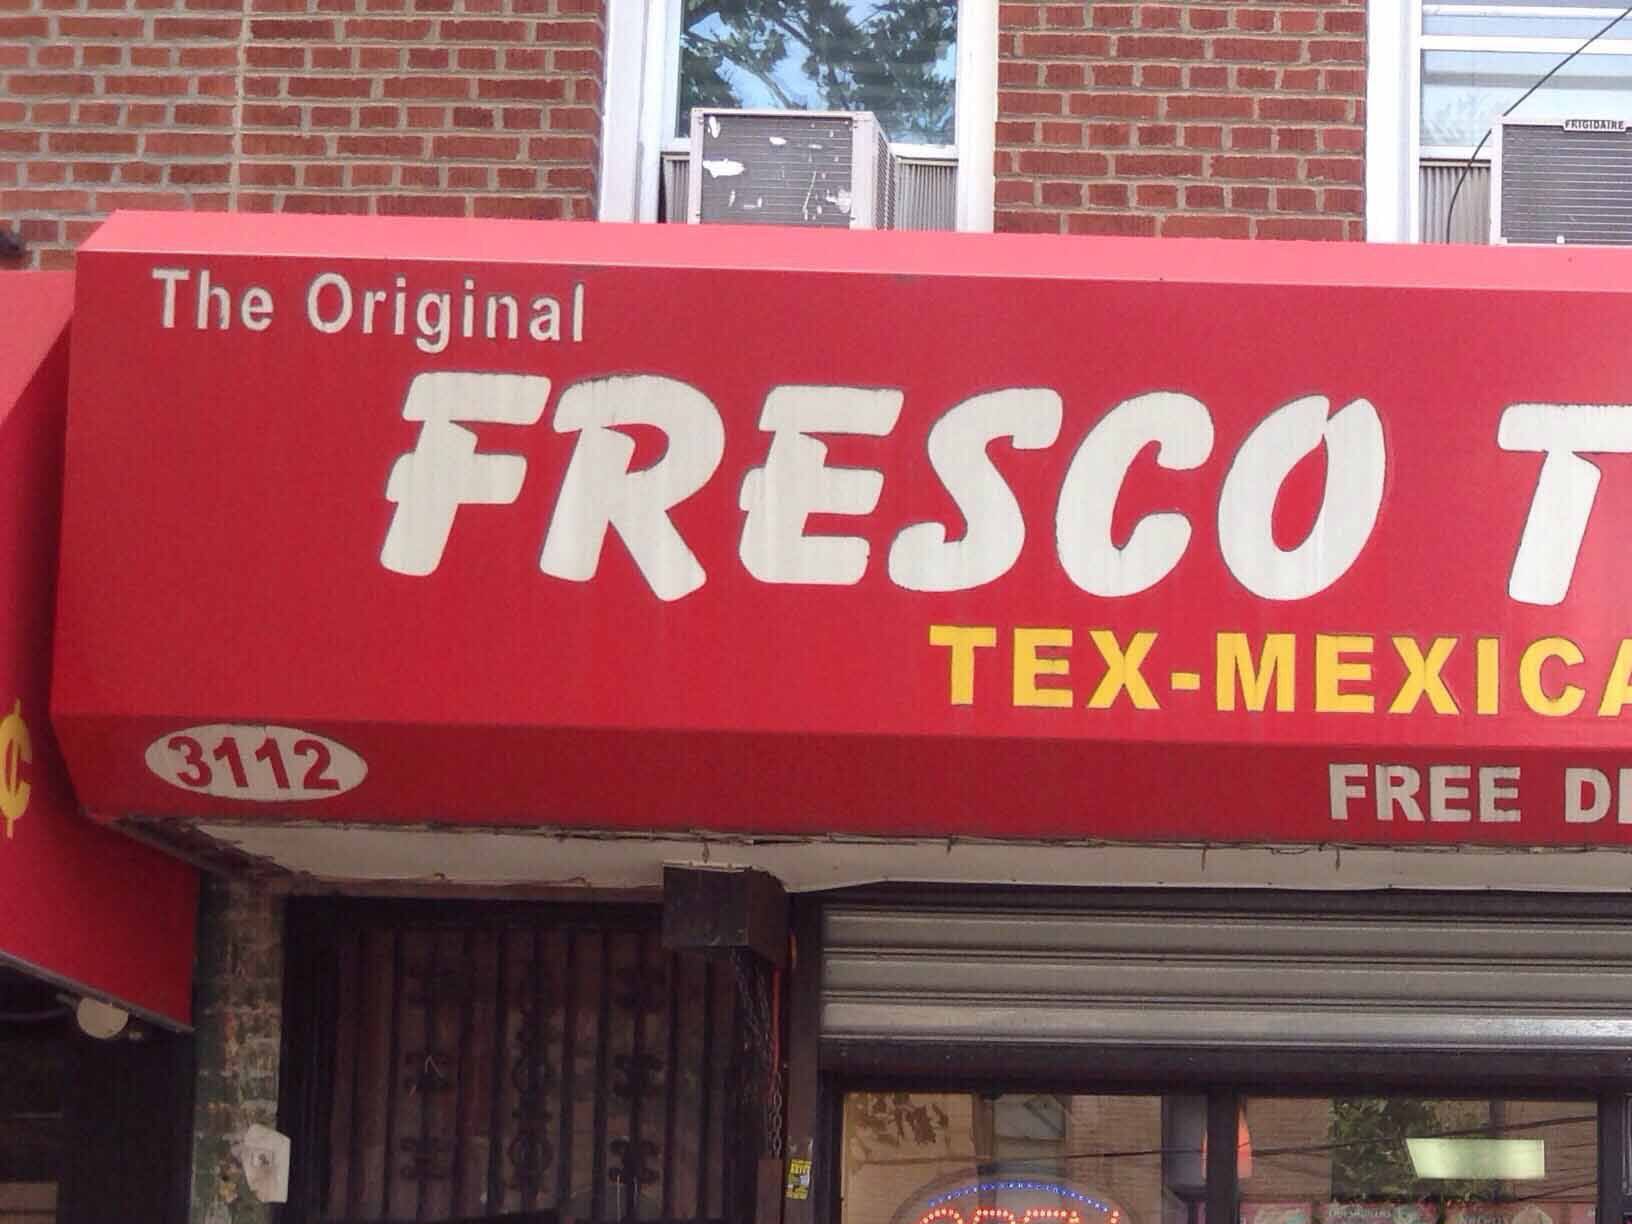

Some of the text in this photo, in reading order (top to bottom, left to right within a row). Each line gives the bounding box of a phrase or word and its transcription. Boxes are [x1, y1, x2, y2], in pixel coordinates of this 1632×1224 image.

[1564, 119, 1625, 130] FRIGIDAIRE
[153, 269, 586, 353] The Original
[380, 372, 1386, 602] FRESCO
[167, 735, 340, 790] 3112
[1329, 764, 1521, 822] FREE
